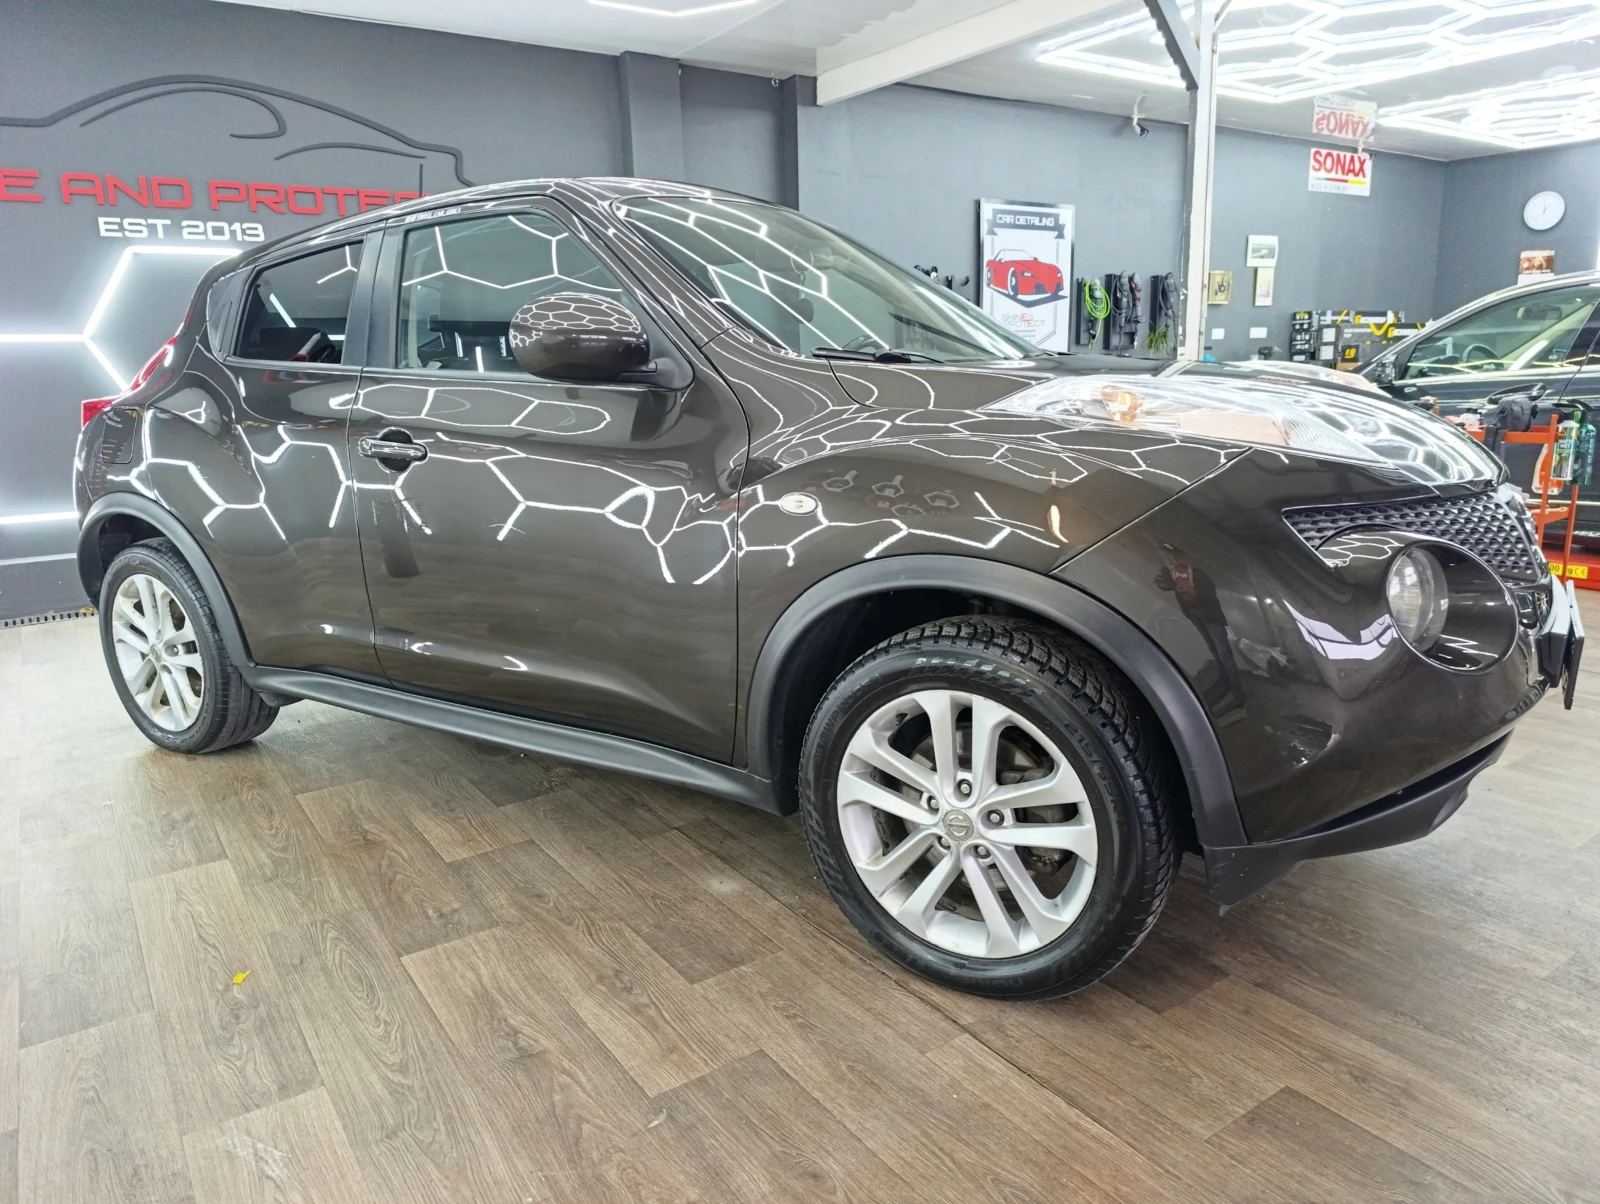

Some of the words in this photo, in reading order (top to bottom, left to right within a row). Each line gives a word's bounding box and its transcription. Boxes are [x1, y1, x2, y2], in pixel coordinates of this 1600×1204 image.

[1312, 149, 1366, 178] SONAX
[60, 172, 193, 208] AND
[208, 179, 432, 215] PROTE
[98, 216, 172, 239] EST
[181, 222, 265, 241] 2013
[997, 214, 1014, 224] CAR
